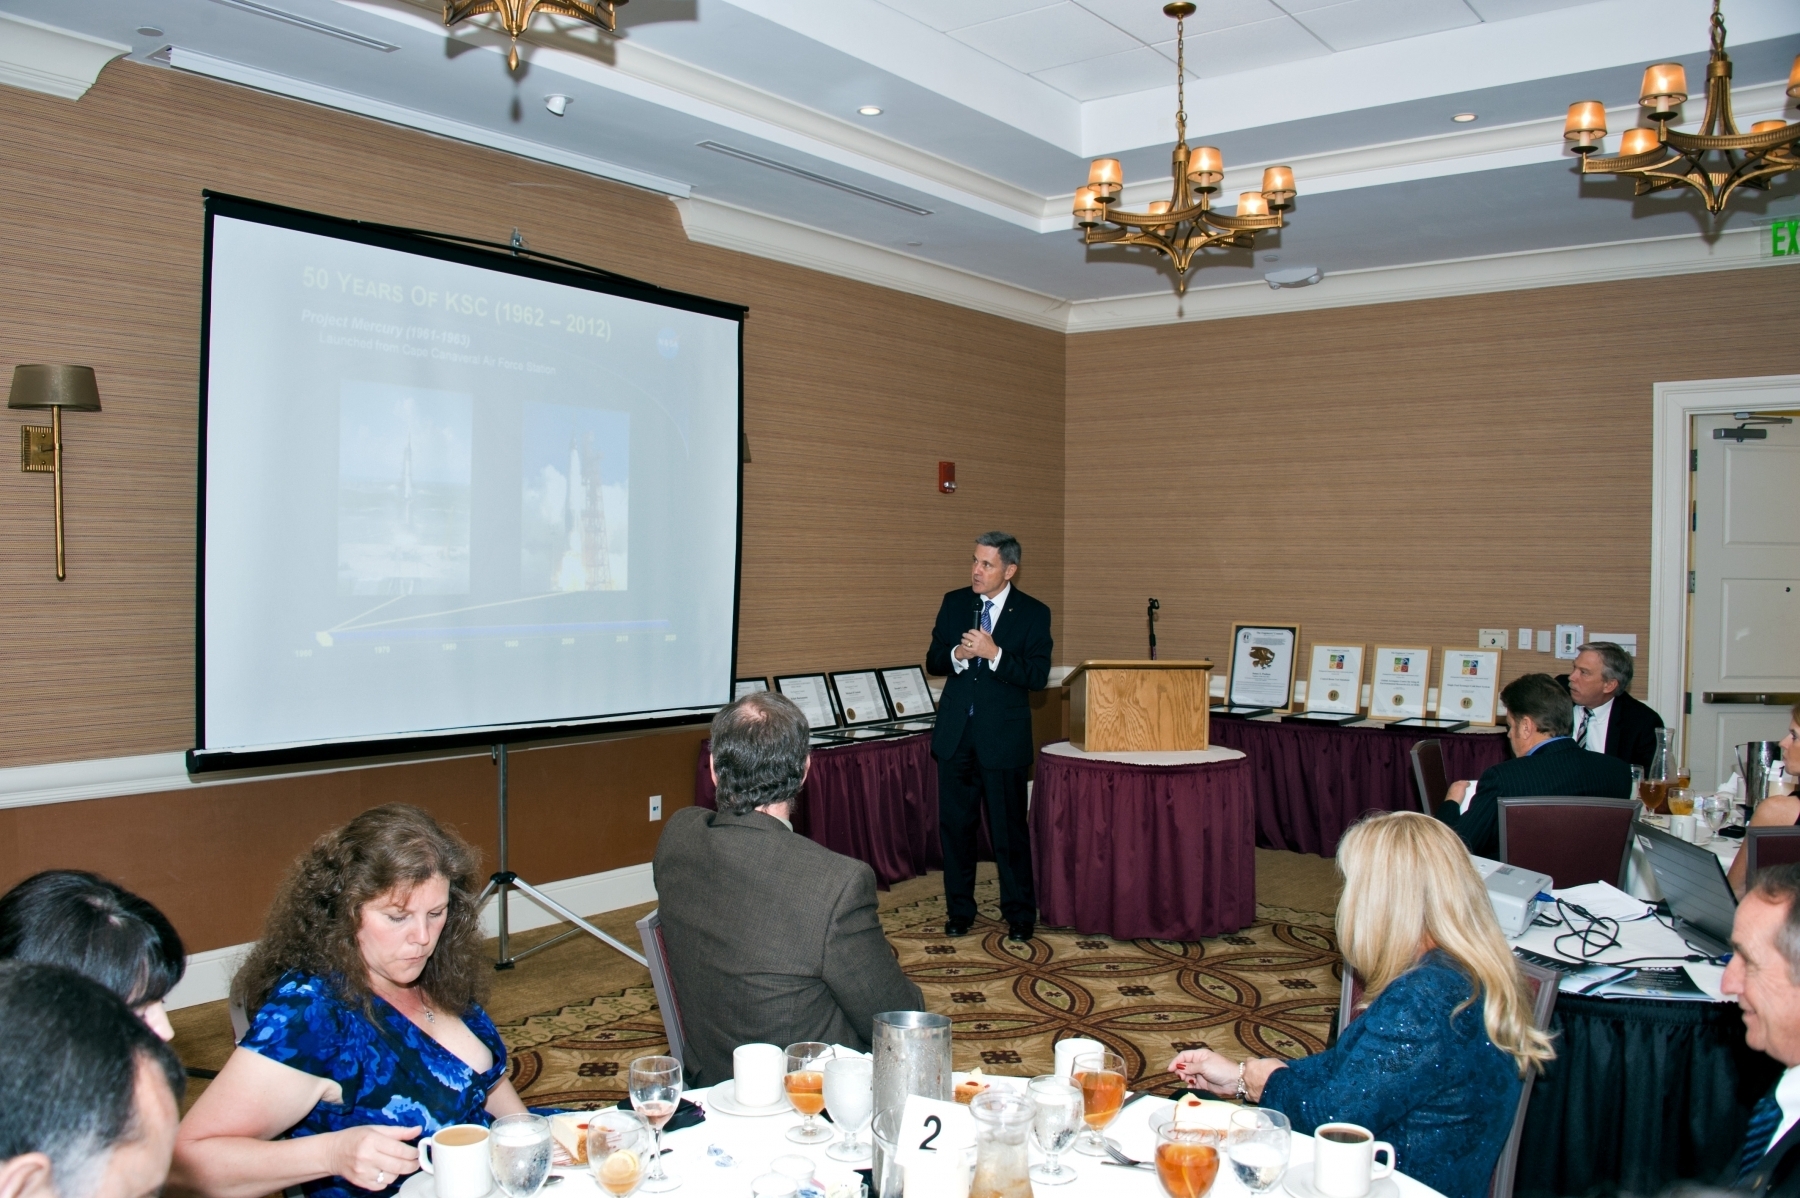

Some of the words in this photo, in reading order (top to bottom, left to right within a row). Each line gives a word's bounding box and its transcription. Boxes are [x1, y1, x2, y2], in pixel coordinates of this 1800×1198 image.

[1771, 219, 1800, 256] EX
[303, 265, 329, 290] 50
[337, 271, 404, 303] YEARS
[445, 290, 488, 317] KSC
[495, 300, 544, 327] (1962
[566, 313, 612, 342] 2012)
[301, 308, 348, 328] Project
[351, 316, 403, 338] Mercury
[406, 325, 470, 349] (1961-1963)
[318, 331, 373, 350] Launched
[375, 338, 399, 354] from
[402, 343, 428, 358] Cape
[431, 347, 480, 364] Canaveral
[482, 355, 496, 367] Air
[498, 357, 524, 371] Force
[526, 361, 556, 375] Station
[374, 645, 391, 655] 1970
[918, 1114, 942, 1151] 2
